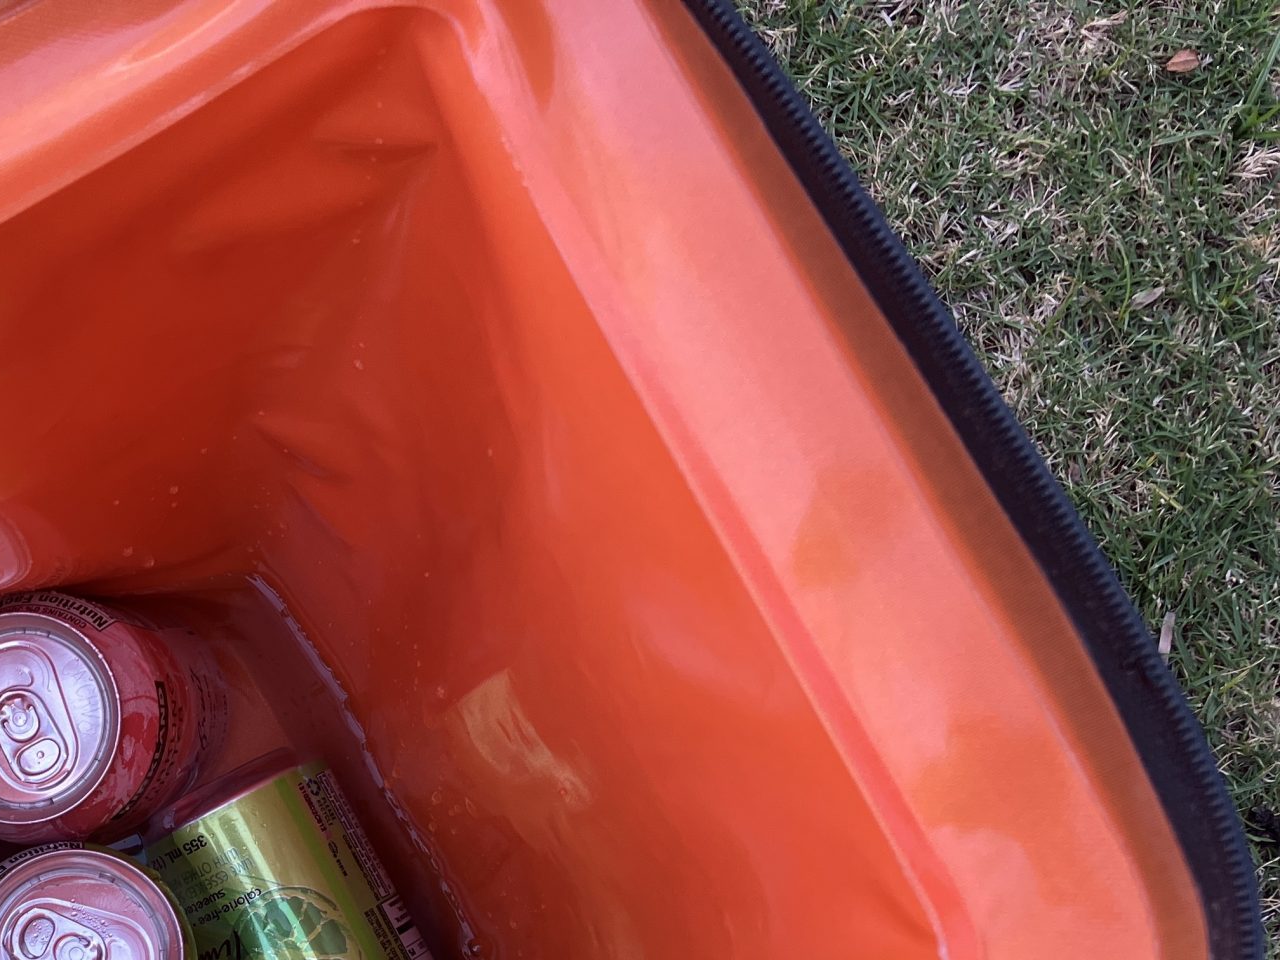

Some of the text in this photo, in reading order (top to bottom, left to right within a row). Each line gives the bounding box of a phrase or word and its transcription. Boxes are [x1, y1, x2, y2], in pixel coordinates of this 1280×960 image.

[37, 592, 108, 628] Nutrition
[163, 833, 207, 865] 355 mL
[197, 884, 264, 930] calorie-free
